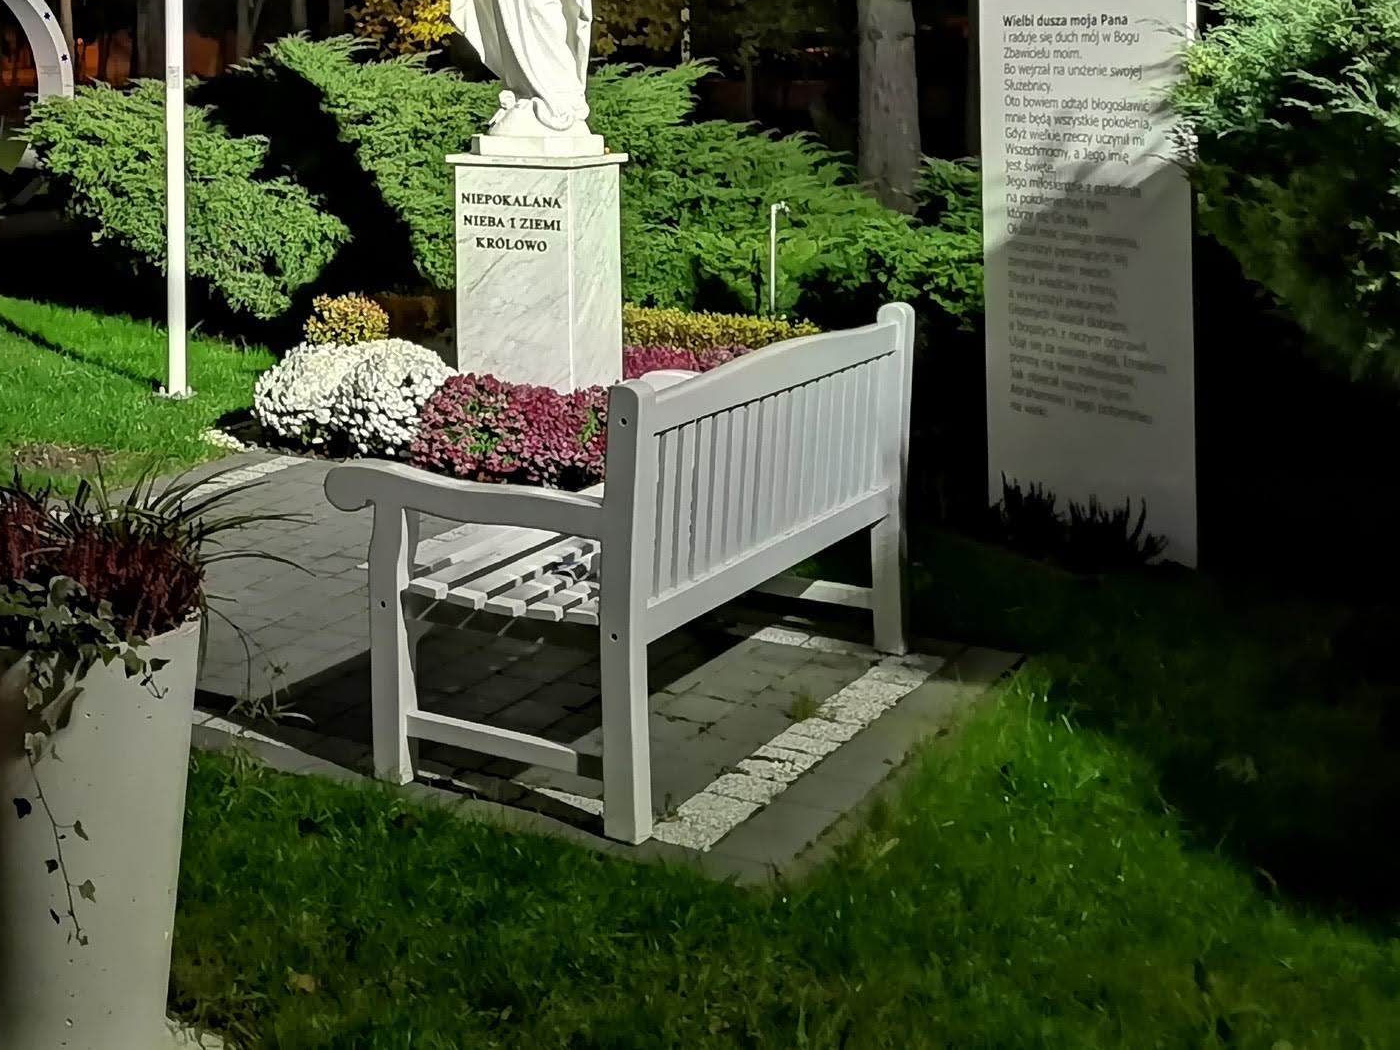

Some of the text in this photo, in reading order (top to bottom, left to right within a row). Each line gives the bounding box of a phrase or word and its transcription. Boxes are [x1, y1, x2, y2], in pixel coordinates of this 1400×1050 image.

[1003, 14, 1128, 29] Wielbi dusza moja Pana
[1008, 31, 1037, 45] raduje
[1040, 32, 1053, 45] się
[1055, 31, 1078, 43] duch
[1081, 30, 1099, 46] mój
[1102, 33, 1111, 42] w
[1114, 31, 1140, 45] Bogu
[1004, 63, 1016, 75] Bo
[1053, 65, 1065, 76] na
[1109, 65, 1142, 80] swojej
[1004, 95, 1020, 107] Oto
[1005, 112, 1152, 131] mnie będą wszystkie pokolenia,
[1063, 132, 1093, 146] rzeczy
[1132, 134, 1144, 146] mi
[1074, 150, 1080, 159] a
[1082, 148, 1106, 163] Jego
[1006, 175, 1027, 190] Jego
[461, 193, 562, 209] NIEPOKALANA
[463, 215, 561, 231] NIEBA I ZIEMI
[476, 236, 547, 252] KRÓLOWO
